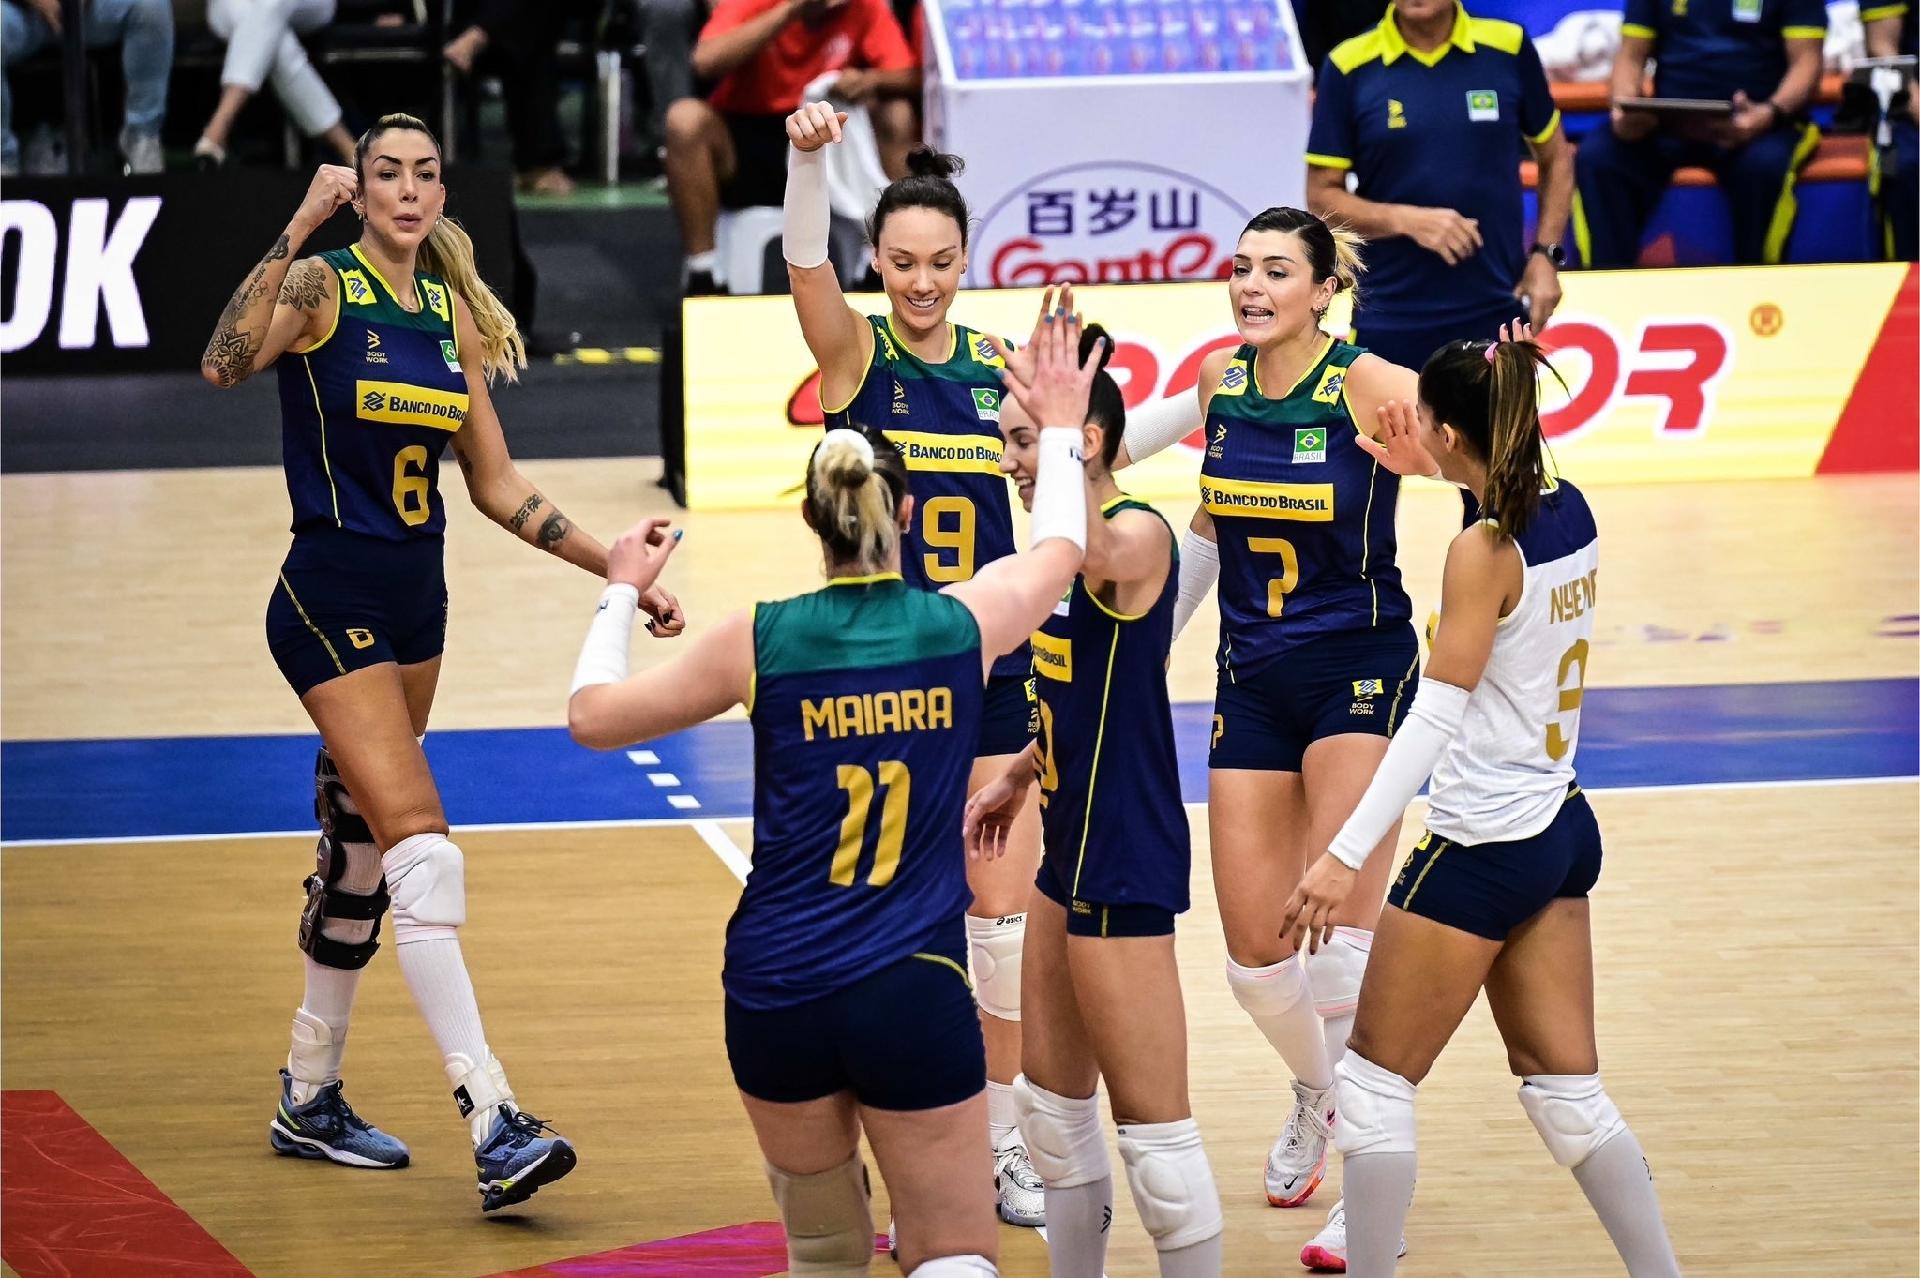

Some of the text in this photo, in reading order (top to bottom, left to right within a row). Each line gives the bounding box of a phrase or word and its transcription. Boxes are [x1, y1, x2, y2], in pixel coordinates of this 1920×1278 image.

[1027, 188, 1198, 235] 百岁山
[389, 396, 465, 421] BANCO DO BRA
[909, 443, 955, 460] BANCO
[957, 447, 974, 460] DO
[1293, 452, 1325, 461] BRASIL
[392, 445, 430, 526] 6
[1213, 490, 1328, 511] BANCO DO BRASIL
[923, 496, 976, 582] 9
[1247, 536, 1299, 618] 7
[801, 686, 953, 741] MAIARA
[1352, 702, 1375, 710] BODY
[1545, 638, 1590, 762] 3
[829, 760, 911, 887] 11
[1006, 916, 1022, 924] asics
